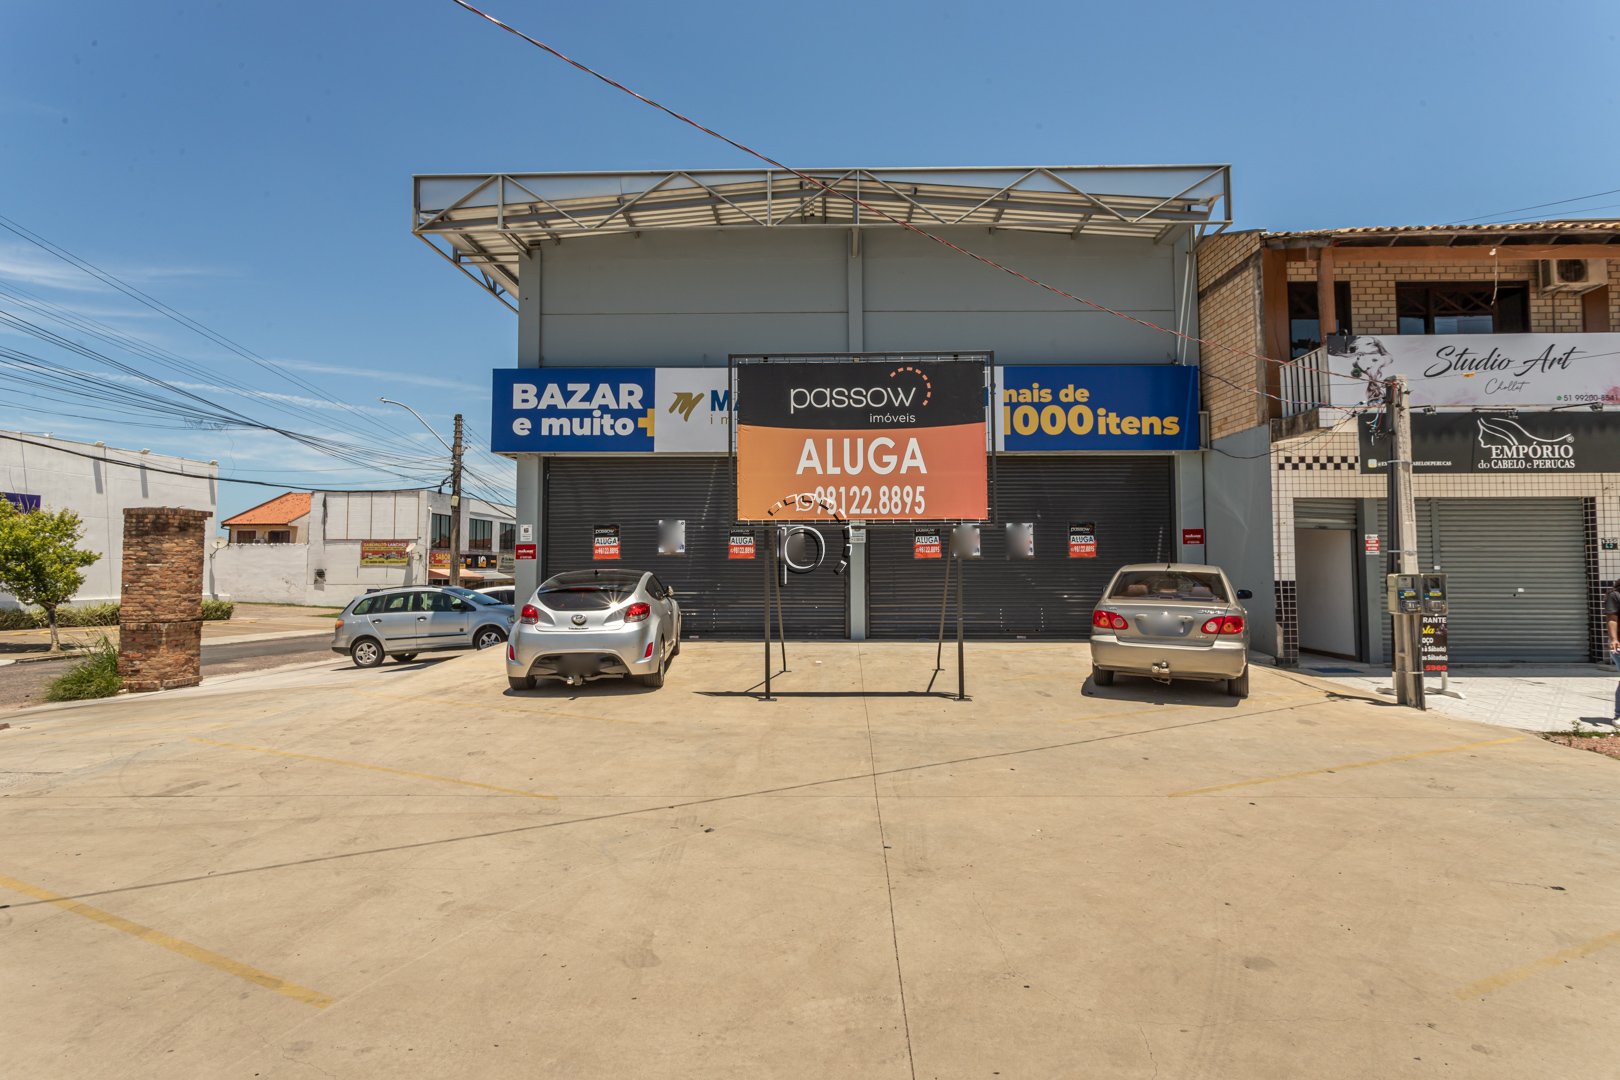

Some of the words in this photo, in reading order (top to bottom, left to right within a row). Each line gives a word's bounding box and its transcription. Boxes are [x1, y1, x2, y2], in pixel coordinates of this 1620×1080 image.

[1424, 345, 1515, 378] Studio
[1514, 343, 1588, 377] Art
[512, 383, 644, 410] BAZAR
[790, 387, 916, 415] passow
[1059, 384, 1090, 403] de
[512, 416, 532, 436] e
[869, 413, 916, 423] imóveis
[1096, 408, 1180, 436] itens
[796, 437, 928, 475] ALUGA
[1490, 441, 1574, 459] EMPÓRIO
[1477, 459, 1490, 469] do
[1491, 459, 1526, 469] CABELO
[1533, 459, 1576, 469] PERUCAS
[815, 485, 925, 514] 98122.8895
[916, 536, 939, 544] ALUGA
